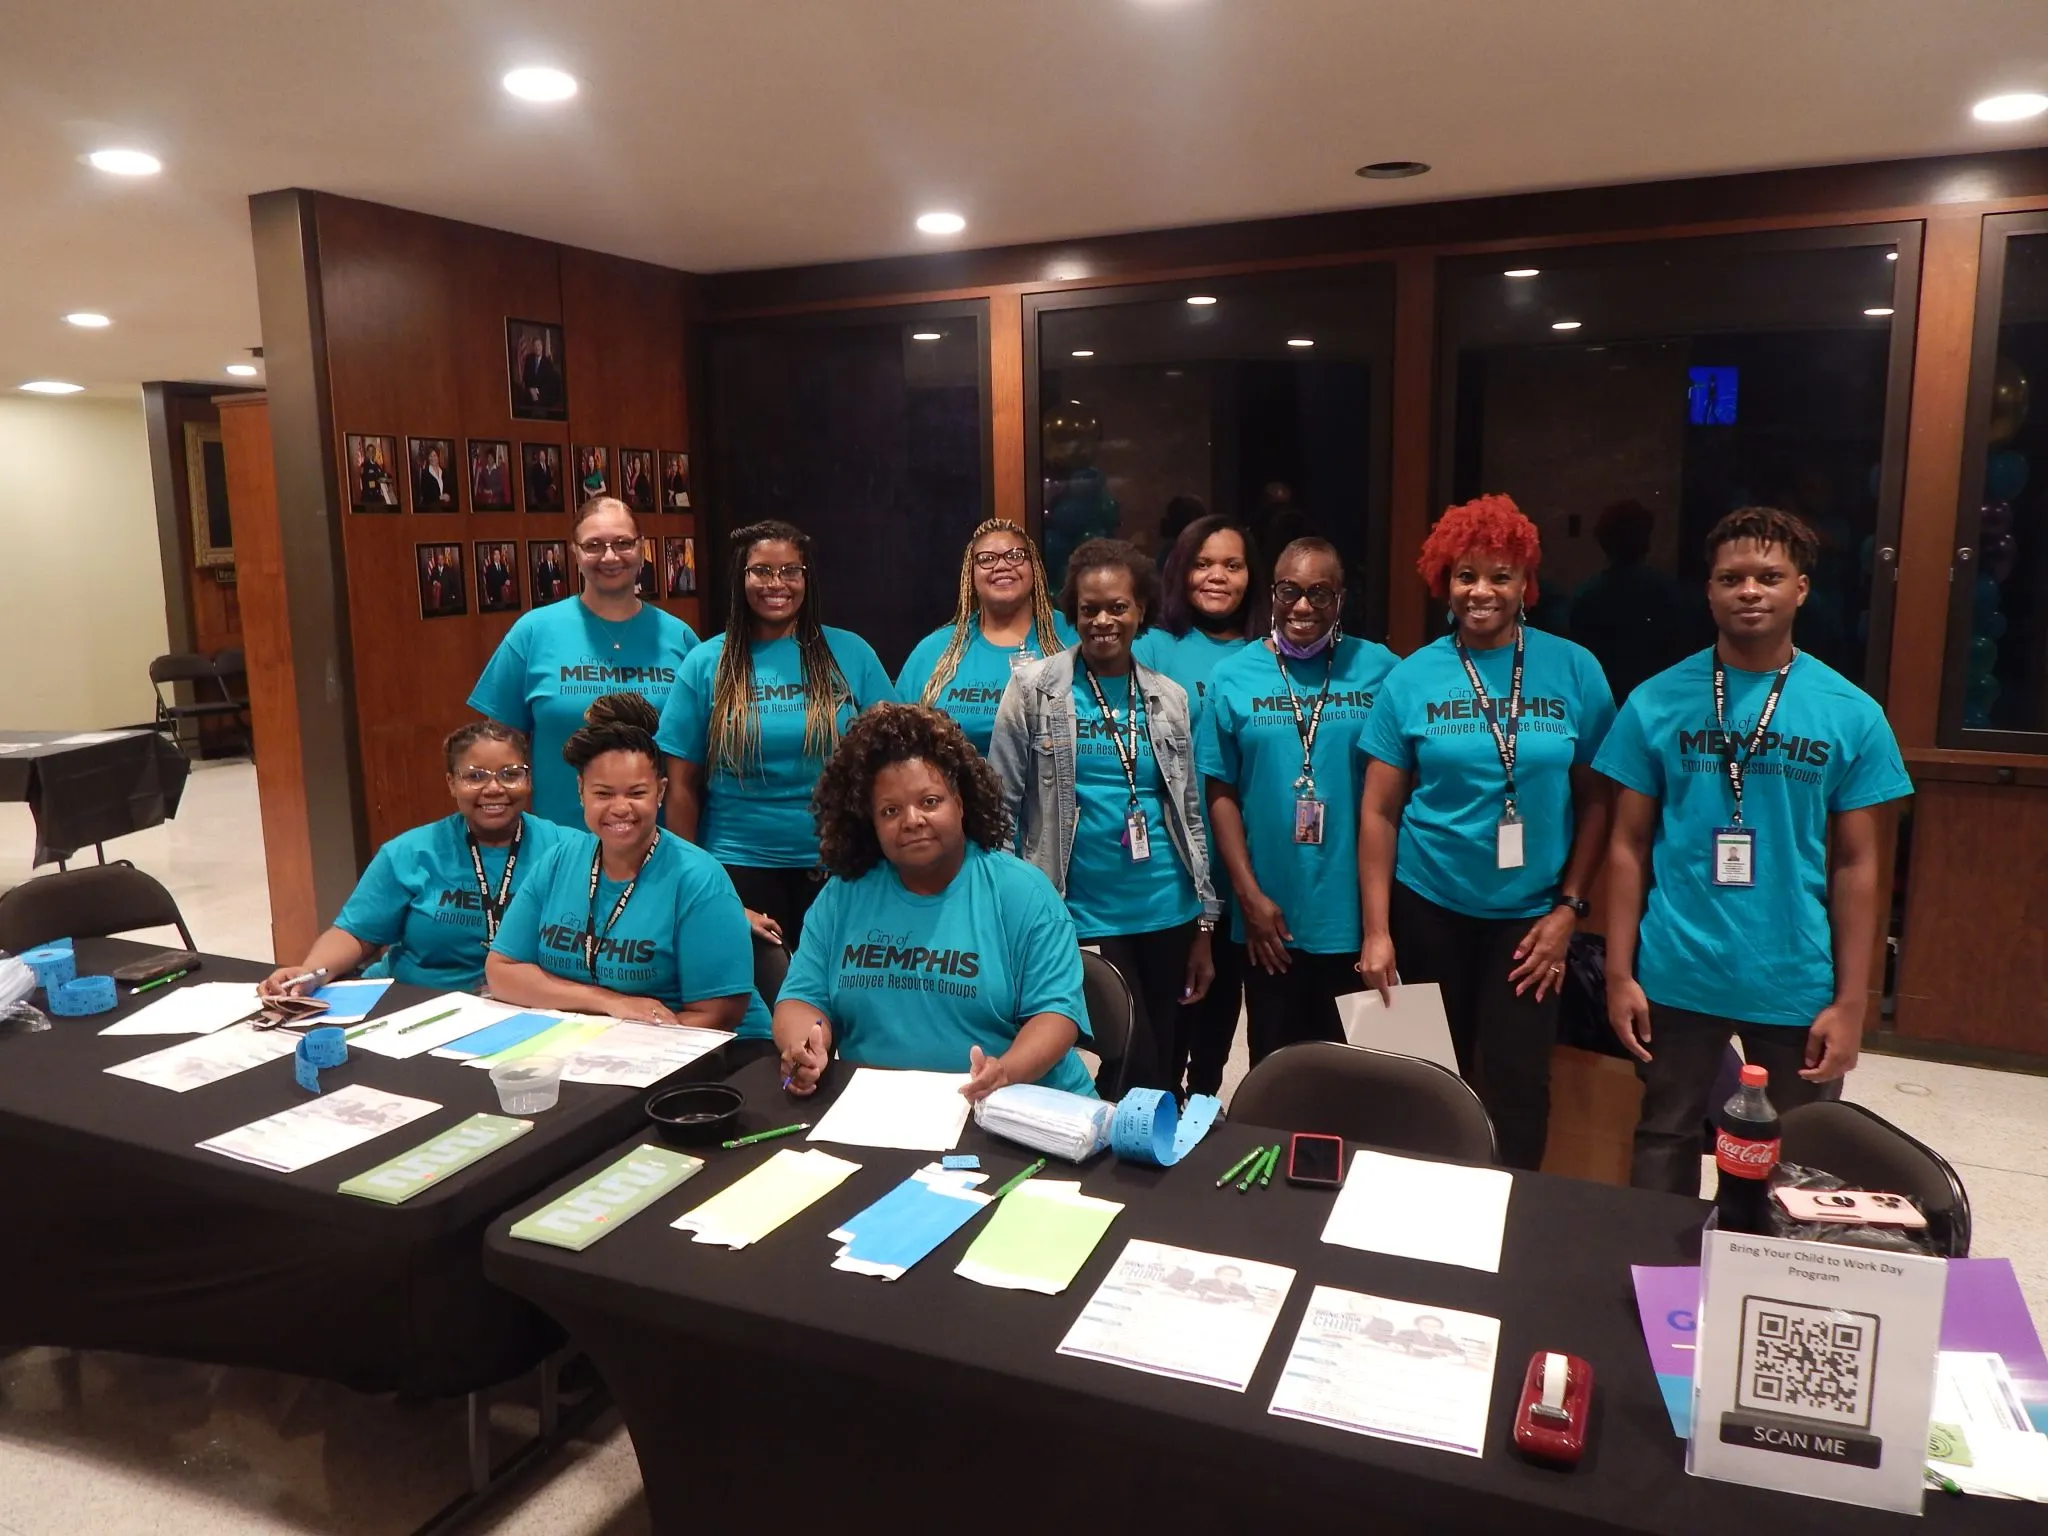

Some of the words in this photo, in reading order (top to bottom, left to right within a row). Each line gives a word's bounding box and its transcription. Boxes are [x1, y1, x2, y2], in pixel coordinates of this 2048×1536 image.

[560, 665, 676, 683] MEMPHIS
[1466, 660, 1480, 687] Memphis
[1514, 667, 1522, 679] City
[1715, 671, 1723, 686] City
[560, 684, 603, 695] Employee
[1426, 697, 1566, 724] MEMPHIS
[1481, 696, 1489, 708] City
[1511, 690, 1520, 718] Memphis
[1760, 693, 1778, 726] Memphis
[1425, 721, 1475, 737] Employee
[1738, 713, 1757, 734] of
[1507, 735, 1516, 748] City
[1679, 730, 1832, 767] MEMPHIS
[1730, 763, 1738, 778] City
[507, 856, 515, 868] City
[434, 910, 483, 927] Employee
[867, 928, 894, 945] City
[896, 930, 913, 950] of
[842, 944, 980, 978] MEMPHIS
[617, 967, 658, 981] Groups
[838, 973, 884, 990] Employee
[887, 974, 935, 991] Resource
[938, 978, 977, 999] Groups
[1140, 1113, 1150, 1136] TICKET
[1730, 1243, 1760, 1257] Bring
[1763, 1247, 1790, 1260] Your
[1794, 1251, 1824, 1264] Child
[1827, 1257, 1840, 1266] to
[1843, 1258, 1877, 1271] Work
[1880, 1263, 1905, 1276] Day
[1788, 1266, 1840, 1282] Program
[1753, 1426, 1808, 1449] SCAN
[1814, 1437, 1847, 1456] ME
